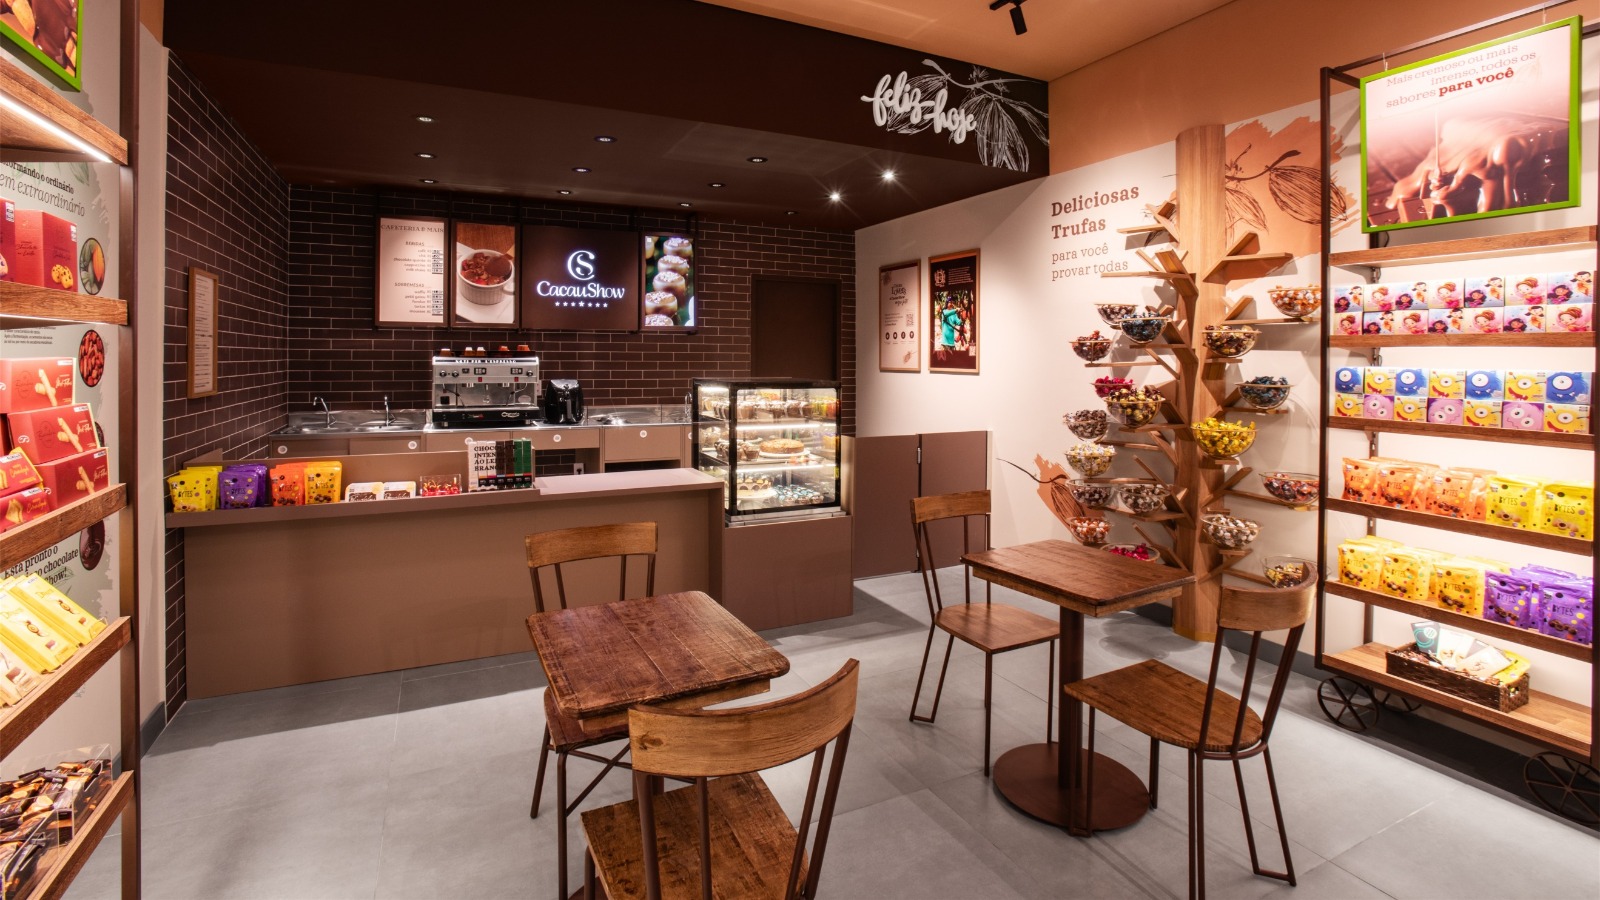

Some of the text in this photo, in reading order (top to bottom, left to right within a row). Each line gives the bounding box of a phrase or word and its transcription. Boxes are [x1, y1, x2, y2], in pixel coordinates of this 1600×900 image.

[1387, 45, 1518, 87] Mais cremoso ou mais
[1481, 57, 1518, 72] todos
[1520, 52, 1536, 62] os
[1386, 67, 1515, 108] sabores para você
[861, 71, 977, 144] feliz hoje
[46, 176, 75, 195] ordinário
[17, 181, 86, 217] extraordinário
[1051, 186, 1140, 217] Deliciosas
[1051, 218, 1106, 239] Trufas
[1051, 242, 1109, 265] para você
[1051, 260, 1129, 281] provar todas
[1554, 504, 1576, 515] BYTES
[24, 548, 52, 572] pronto
[53, 545, 58, 555] o
[43, 548, 79, 574] chocolate
[1552, 604, 1575, 617] BYTES
